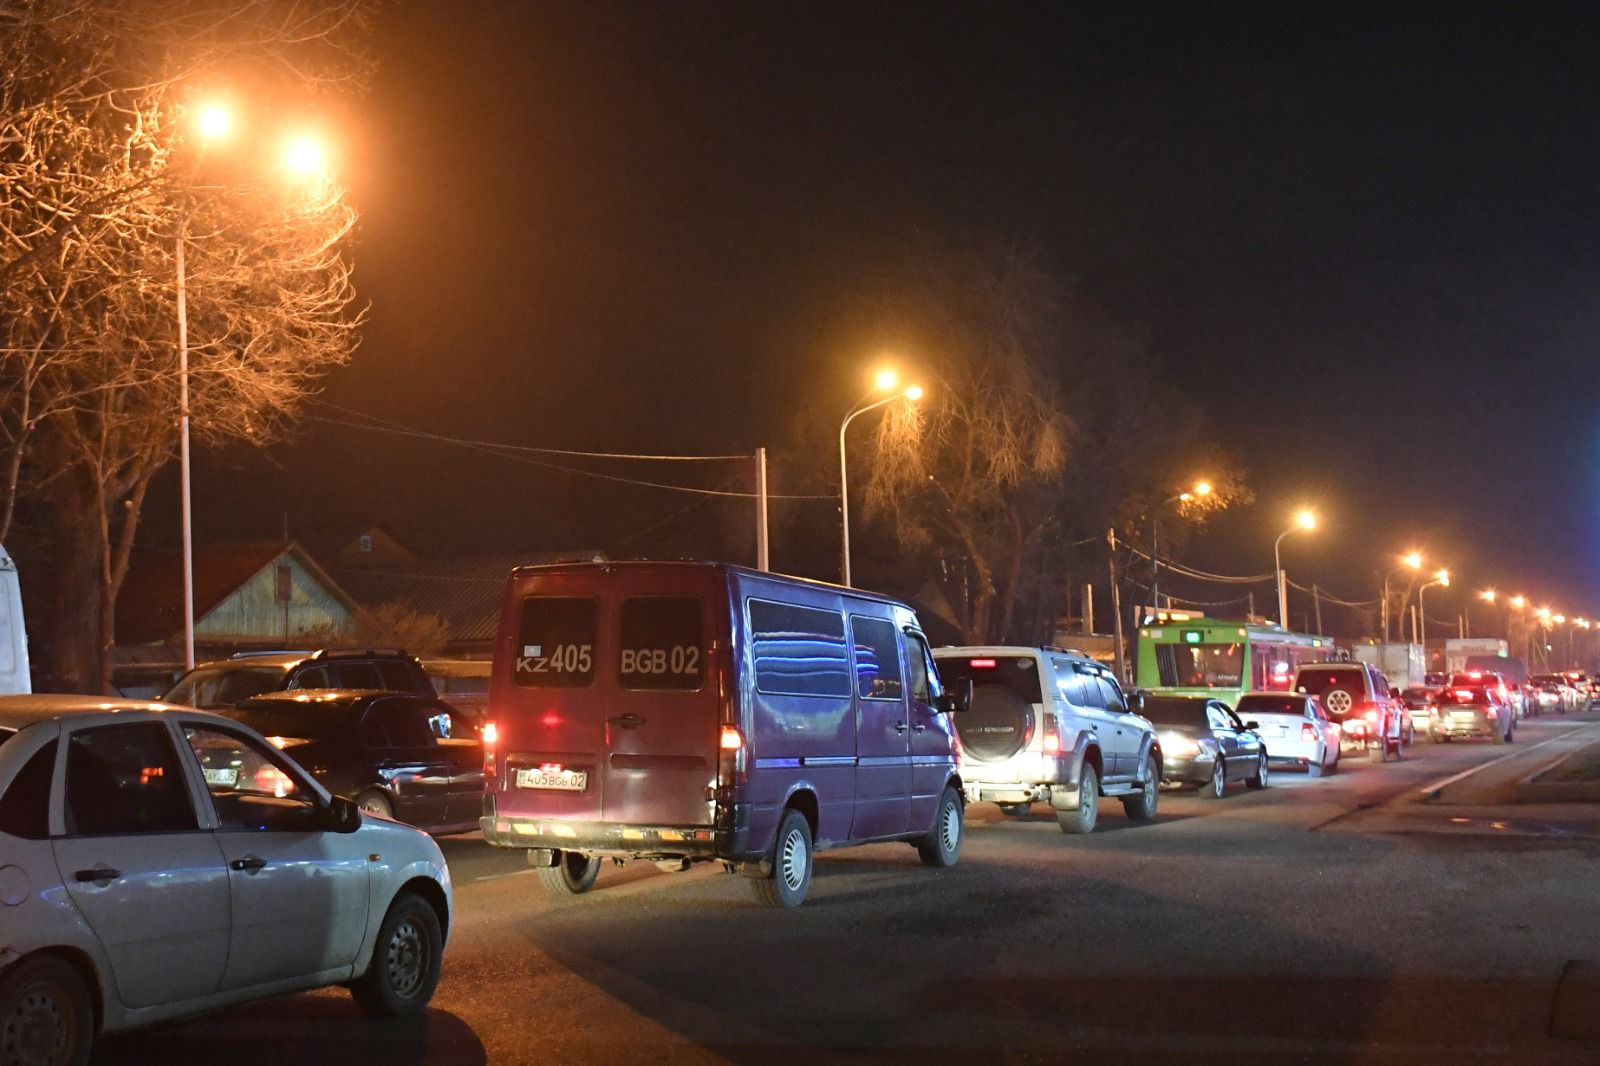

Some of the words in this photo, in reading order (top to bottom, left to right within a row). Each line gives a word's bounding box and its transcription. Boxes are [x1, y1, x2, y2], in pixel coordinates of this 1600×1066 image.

[516, 657, 548, 673] KZ
[550, 644, 592, 673] 405
[621, 649, 667, 674] BGB
[671, 645, 700, 674] 02
[527, 773, 548, 786] 405
[548, 776, 568, 787] BGB
[570, 774, 585, 788] 02
